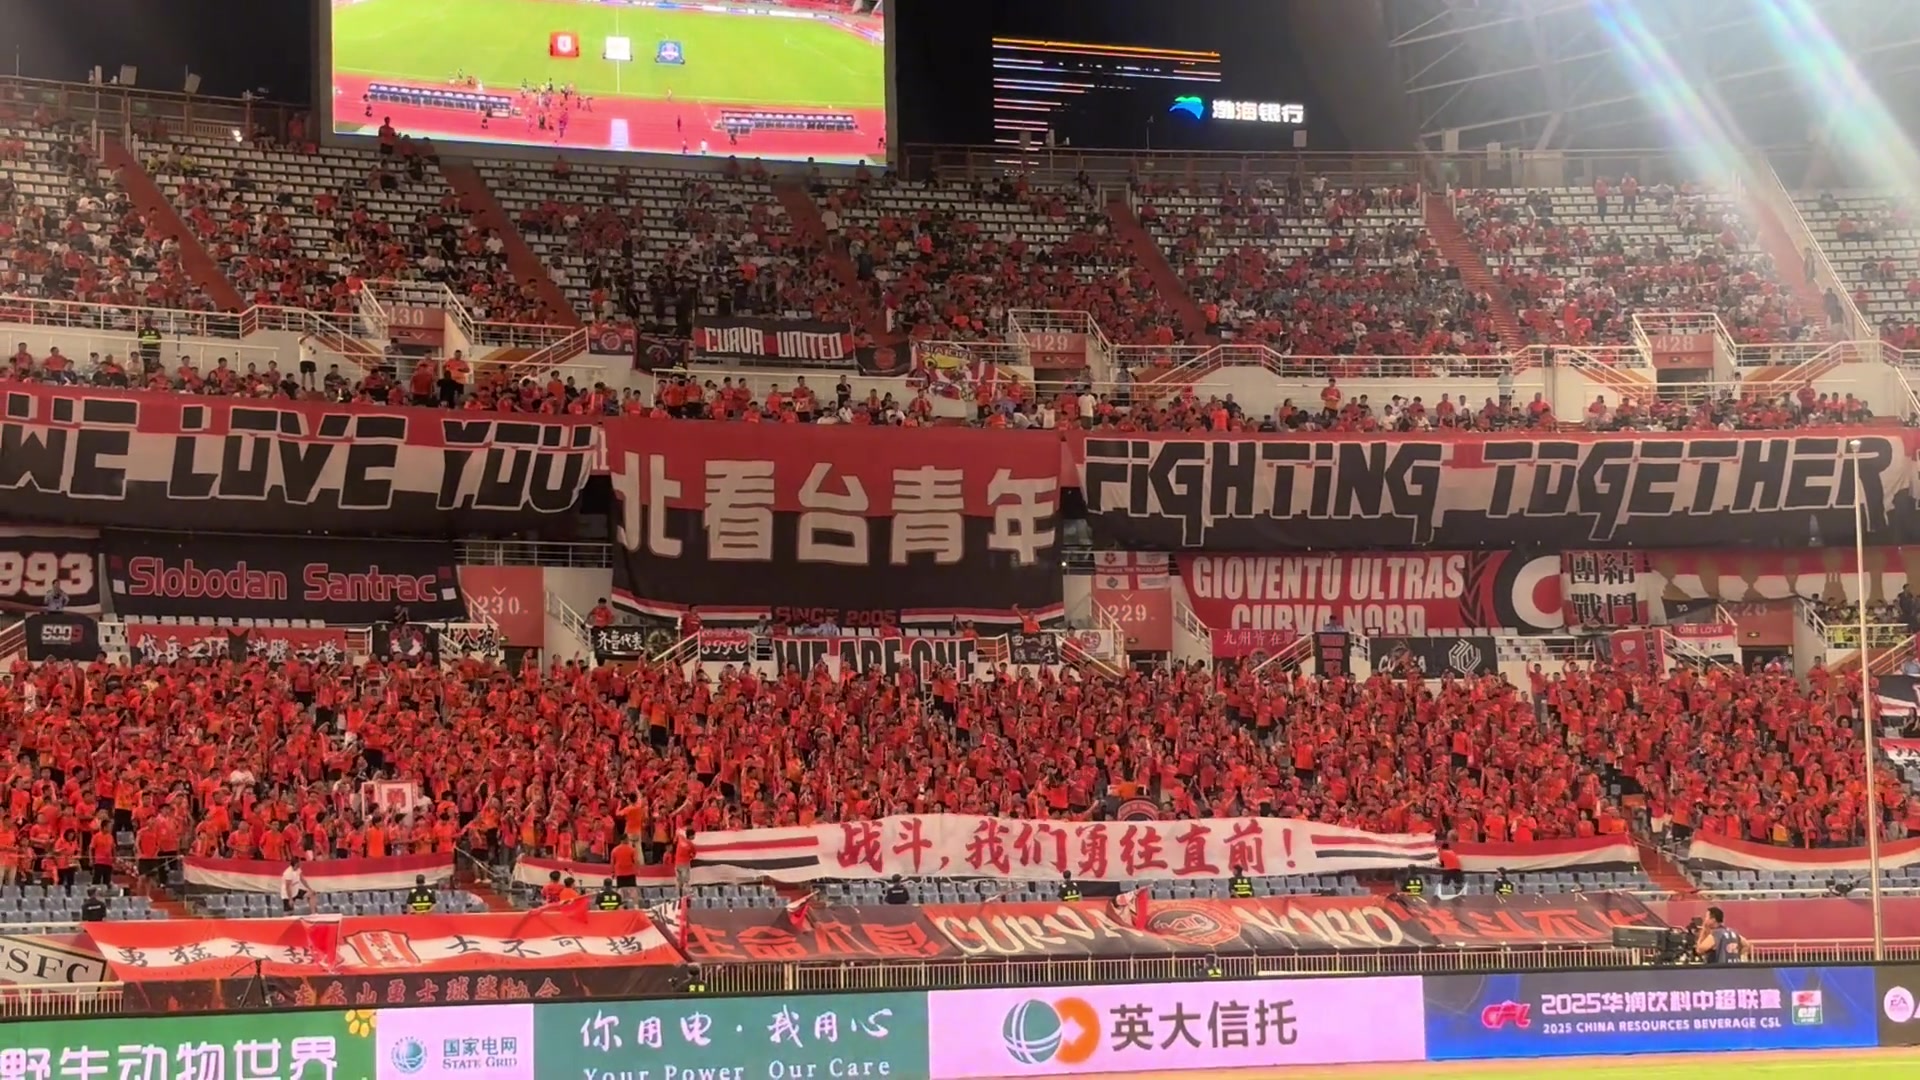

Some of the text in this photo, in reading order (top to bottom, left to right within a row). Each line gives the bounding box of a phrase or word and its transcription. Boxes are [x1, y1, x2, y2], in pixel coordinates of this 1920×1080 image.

[1211, 99, 1304, 124] 渤海银行
[705, 327, 844, 360] CURVA UNITED
[1656, 334, 1695, 351] 428
[0, 392, 600, 514] WE LOVE YOU
[611, 449, 1059, 567] 北看台青年
[1084, 436, 1894, 547] FIGHTING TOGETHER
[127, 556, 437, 602] Slobodan Santrac
[1349, 554, 1466, 600] ULTRAS
[1568, 551, 1636, 585] 團結
[1107, 604, 1147, 622] 229
[1343, 604, 1426, 637] NORD
[1679, 625, 1724, 635] ONE LOVE
[773, 638, 830, 682] WE
[910, 638, 976, 688] ONE
[0, 946, 90, 984] SFC
[1541, 988, 1782, 1016] 2025华润饮料中超联赛
[1109, 999, 1299, 1052] 英大信托
[1543, 1017, 1782, 1035] 2025 CHINA RESOURCES BEVERAGE CSL
[0, 1035, 339, 1080] 野生动物世界
[443, 1036, 519, 1057] 国家电网
[583, 1057, 891, 1080] Your Power Our Care
